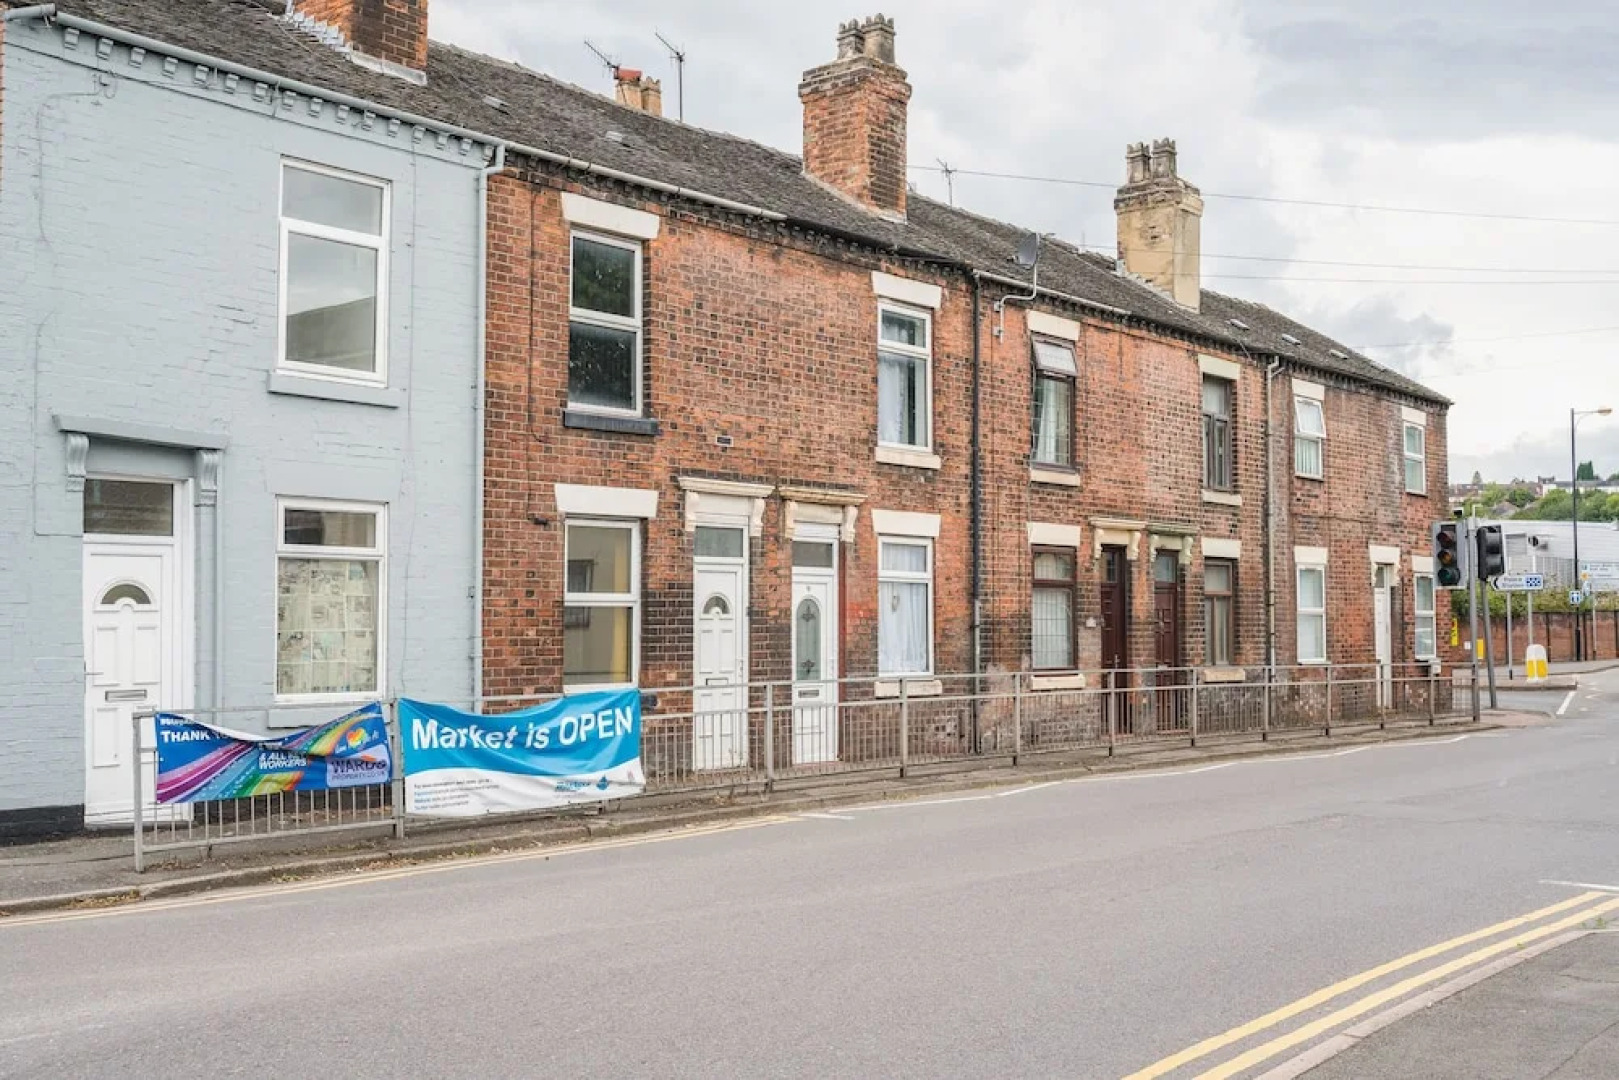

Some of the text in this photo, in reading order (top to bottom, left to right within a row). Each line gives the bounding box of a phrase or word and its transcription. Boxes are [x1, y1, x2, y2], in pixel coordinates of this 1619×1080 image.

[412, 718, 518, 750] Market
[525, 722, 549, 749] is
[559, 705, 633, 746] OPEN
[160, 730, 210, 743] THANK
[259, 757, 307, 769] WORKERS
